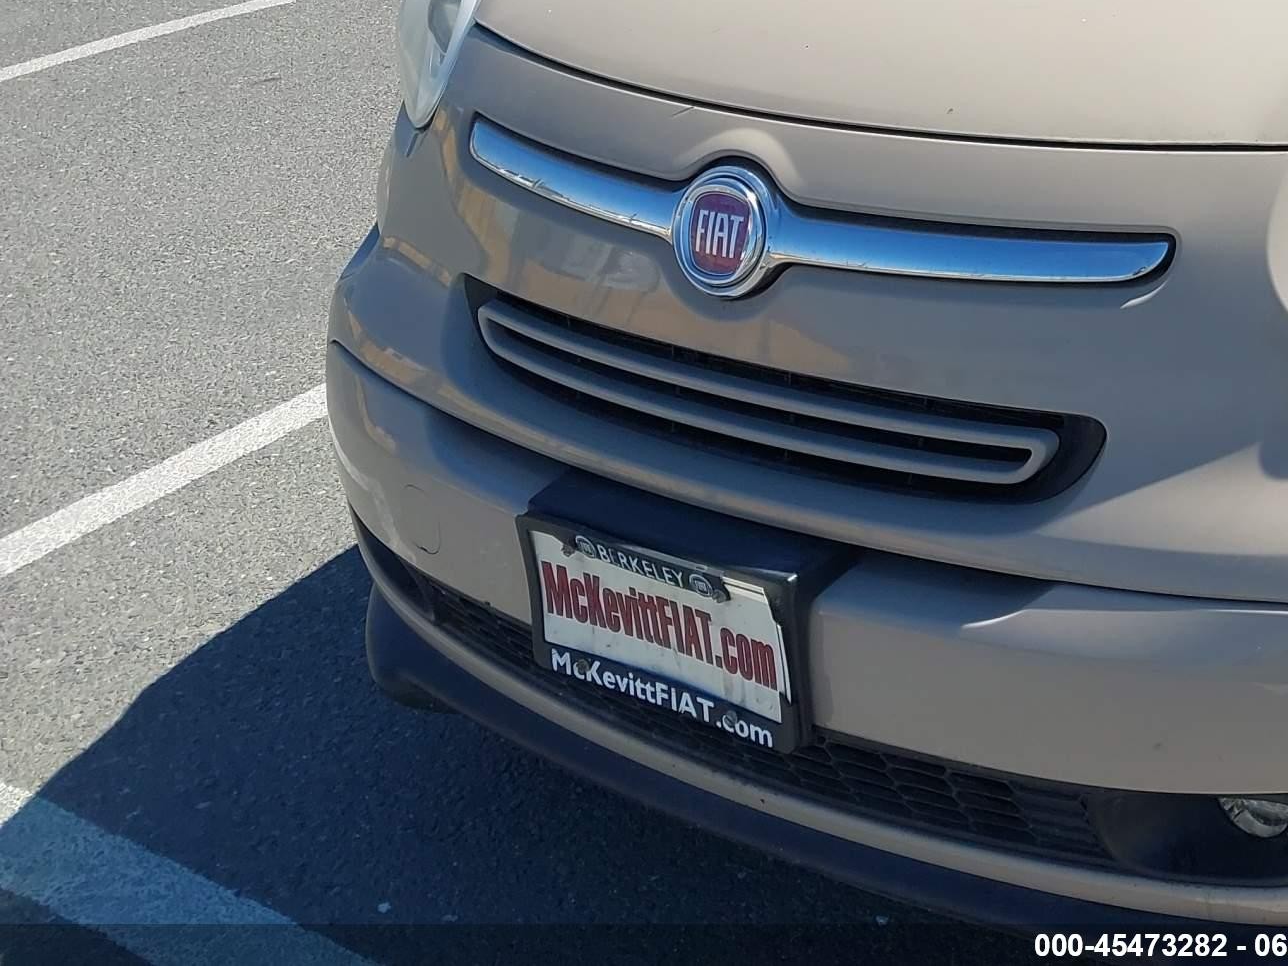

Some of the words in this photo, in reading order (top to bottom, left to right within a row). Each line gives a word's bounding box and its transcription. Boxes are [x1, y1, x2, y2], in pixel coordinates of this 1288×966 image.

[695, 209, 744, 259] FIAT
[540, 559, 779, 692] McKevittFIAT.com
[551, 648, 774, 748] McKevittFIAT.com
